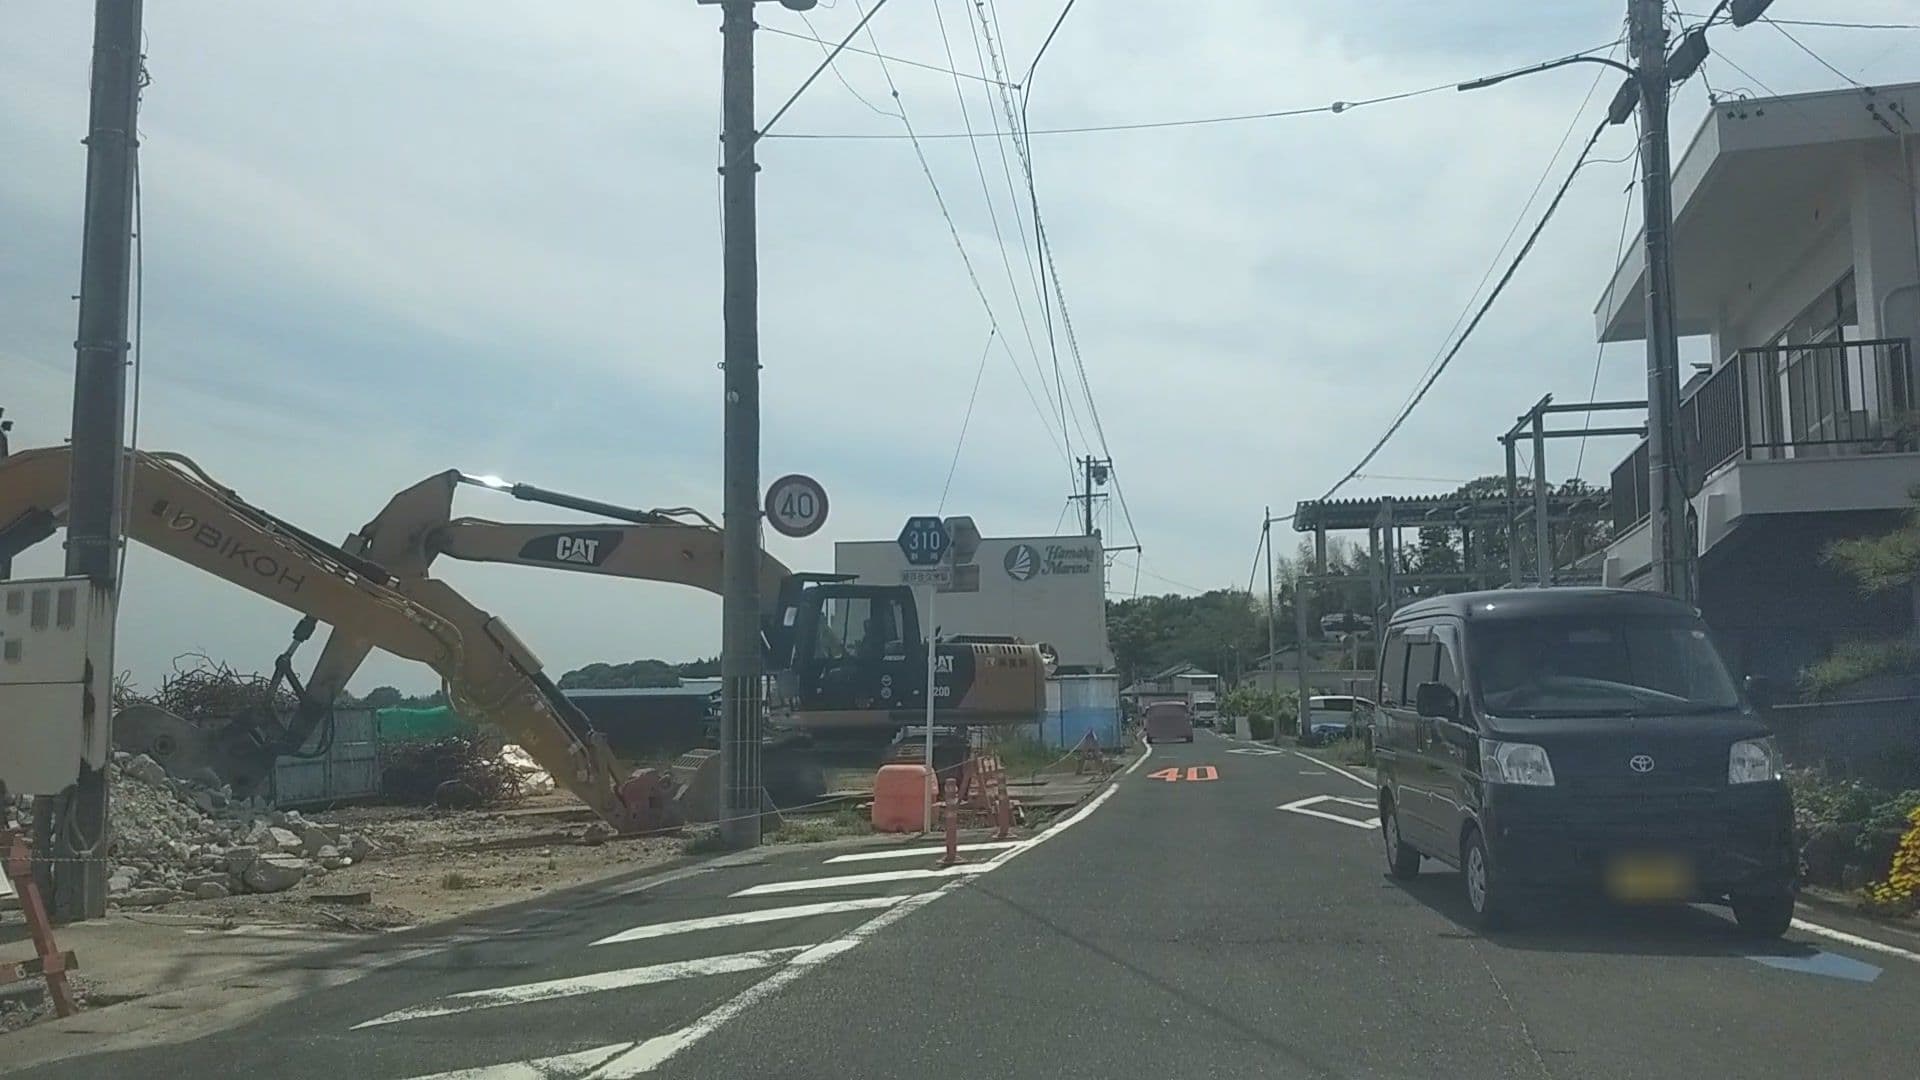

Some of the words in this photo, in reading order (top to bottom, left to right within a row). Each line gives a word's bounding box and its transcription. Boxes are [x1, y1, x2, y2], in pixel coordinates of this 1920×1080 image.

[781, 492, 813, 520] 40
[556, 535, 599, 564] CAT
[909, 530, 940, 550] 310
[193, 523, 306, 593] BIKOH
[1147, 765, 1219, 782] 40
